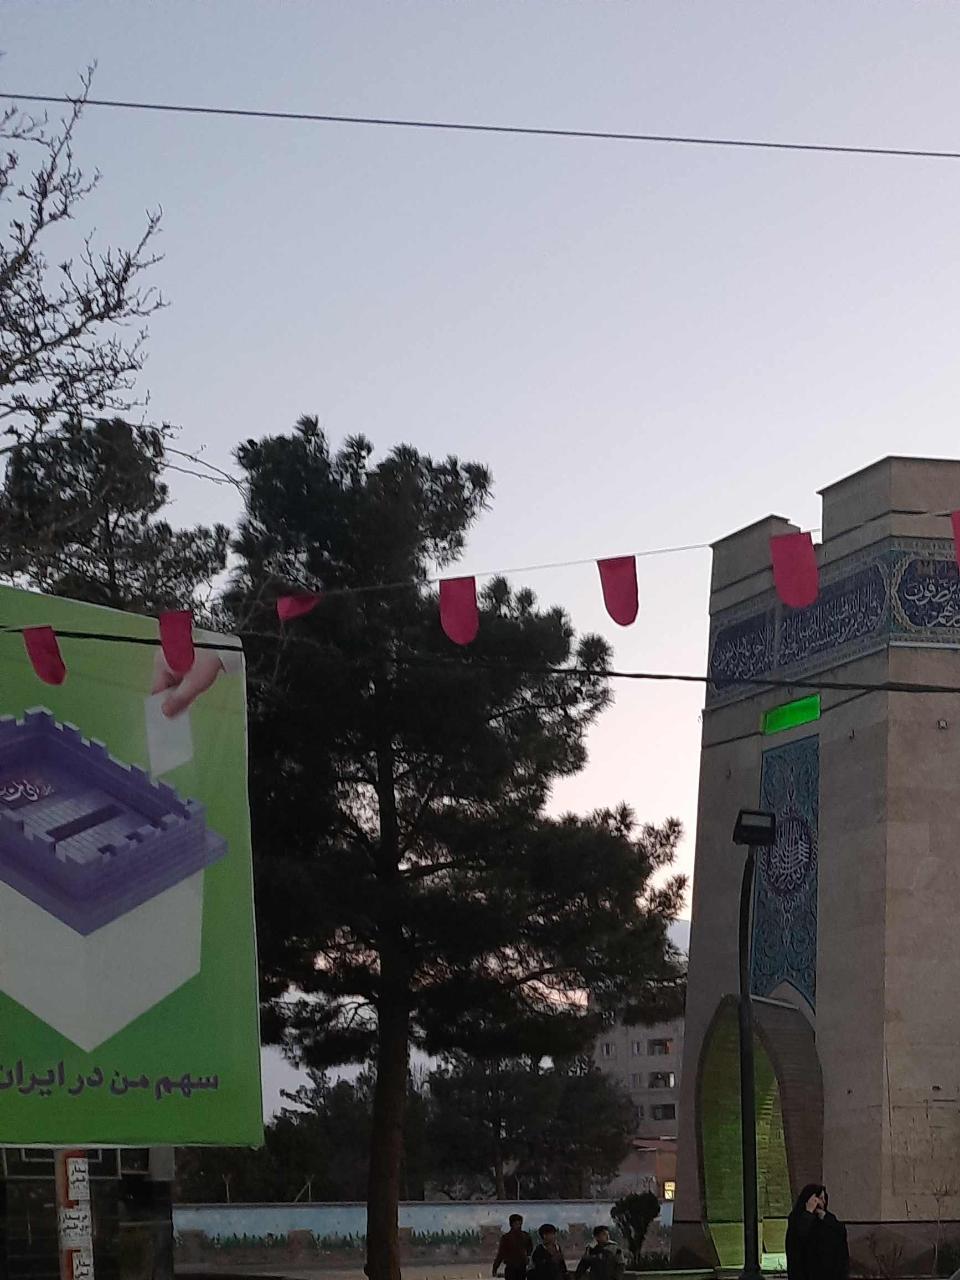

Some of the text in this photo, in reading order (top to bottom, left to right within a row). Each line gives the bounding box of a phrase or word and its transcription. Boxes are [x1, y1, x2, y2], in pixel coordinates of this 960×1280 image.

[68, 1066, 104, 1096] در
[110, 1070, 150, 1096] من
[155, 1071, 219, 1101] سهم
